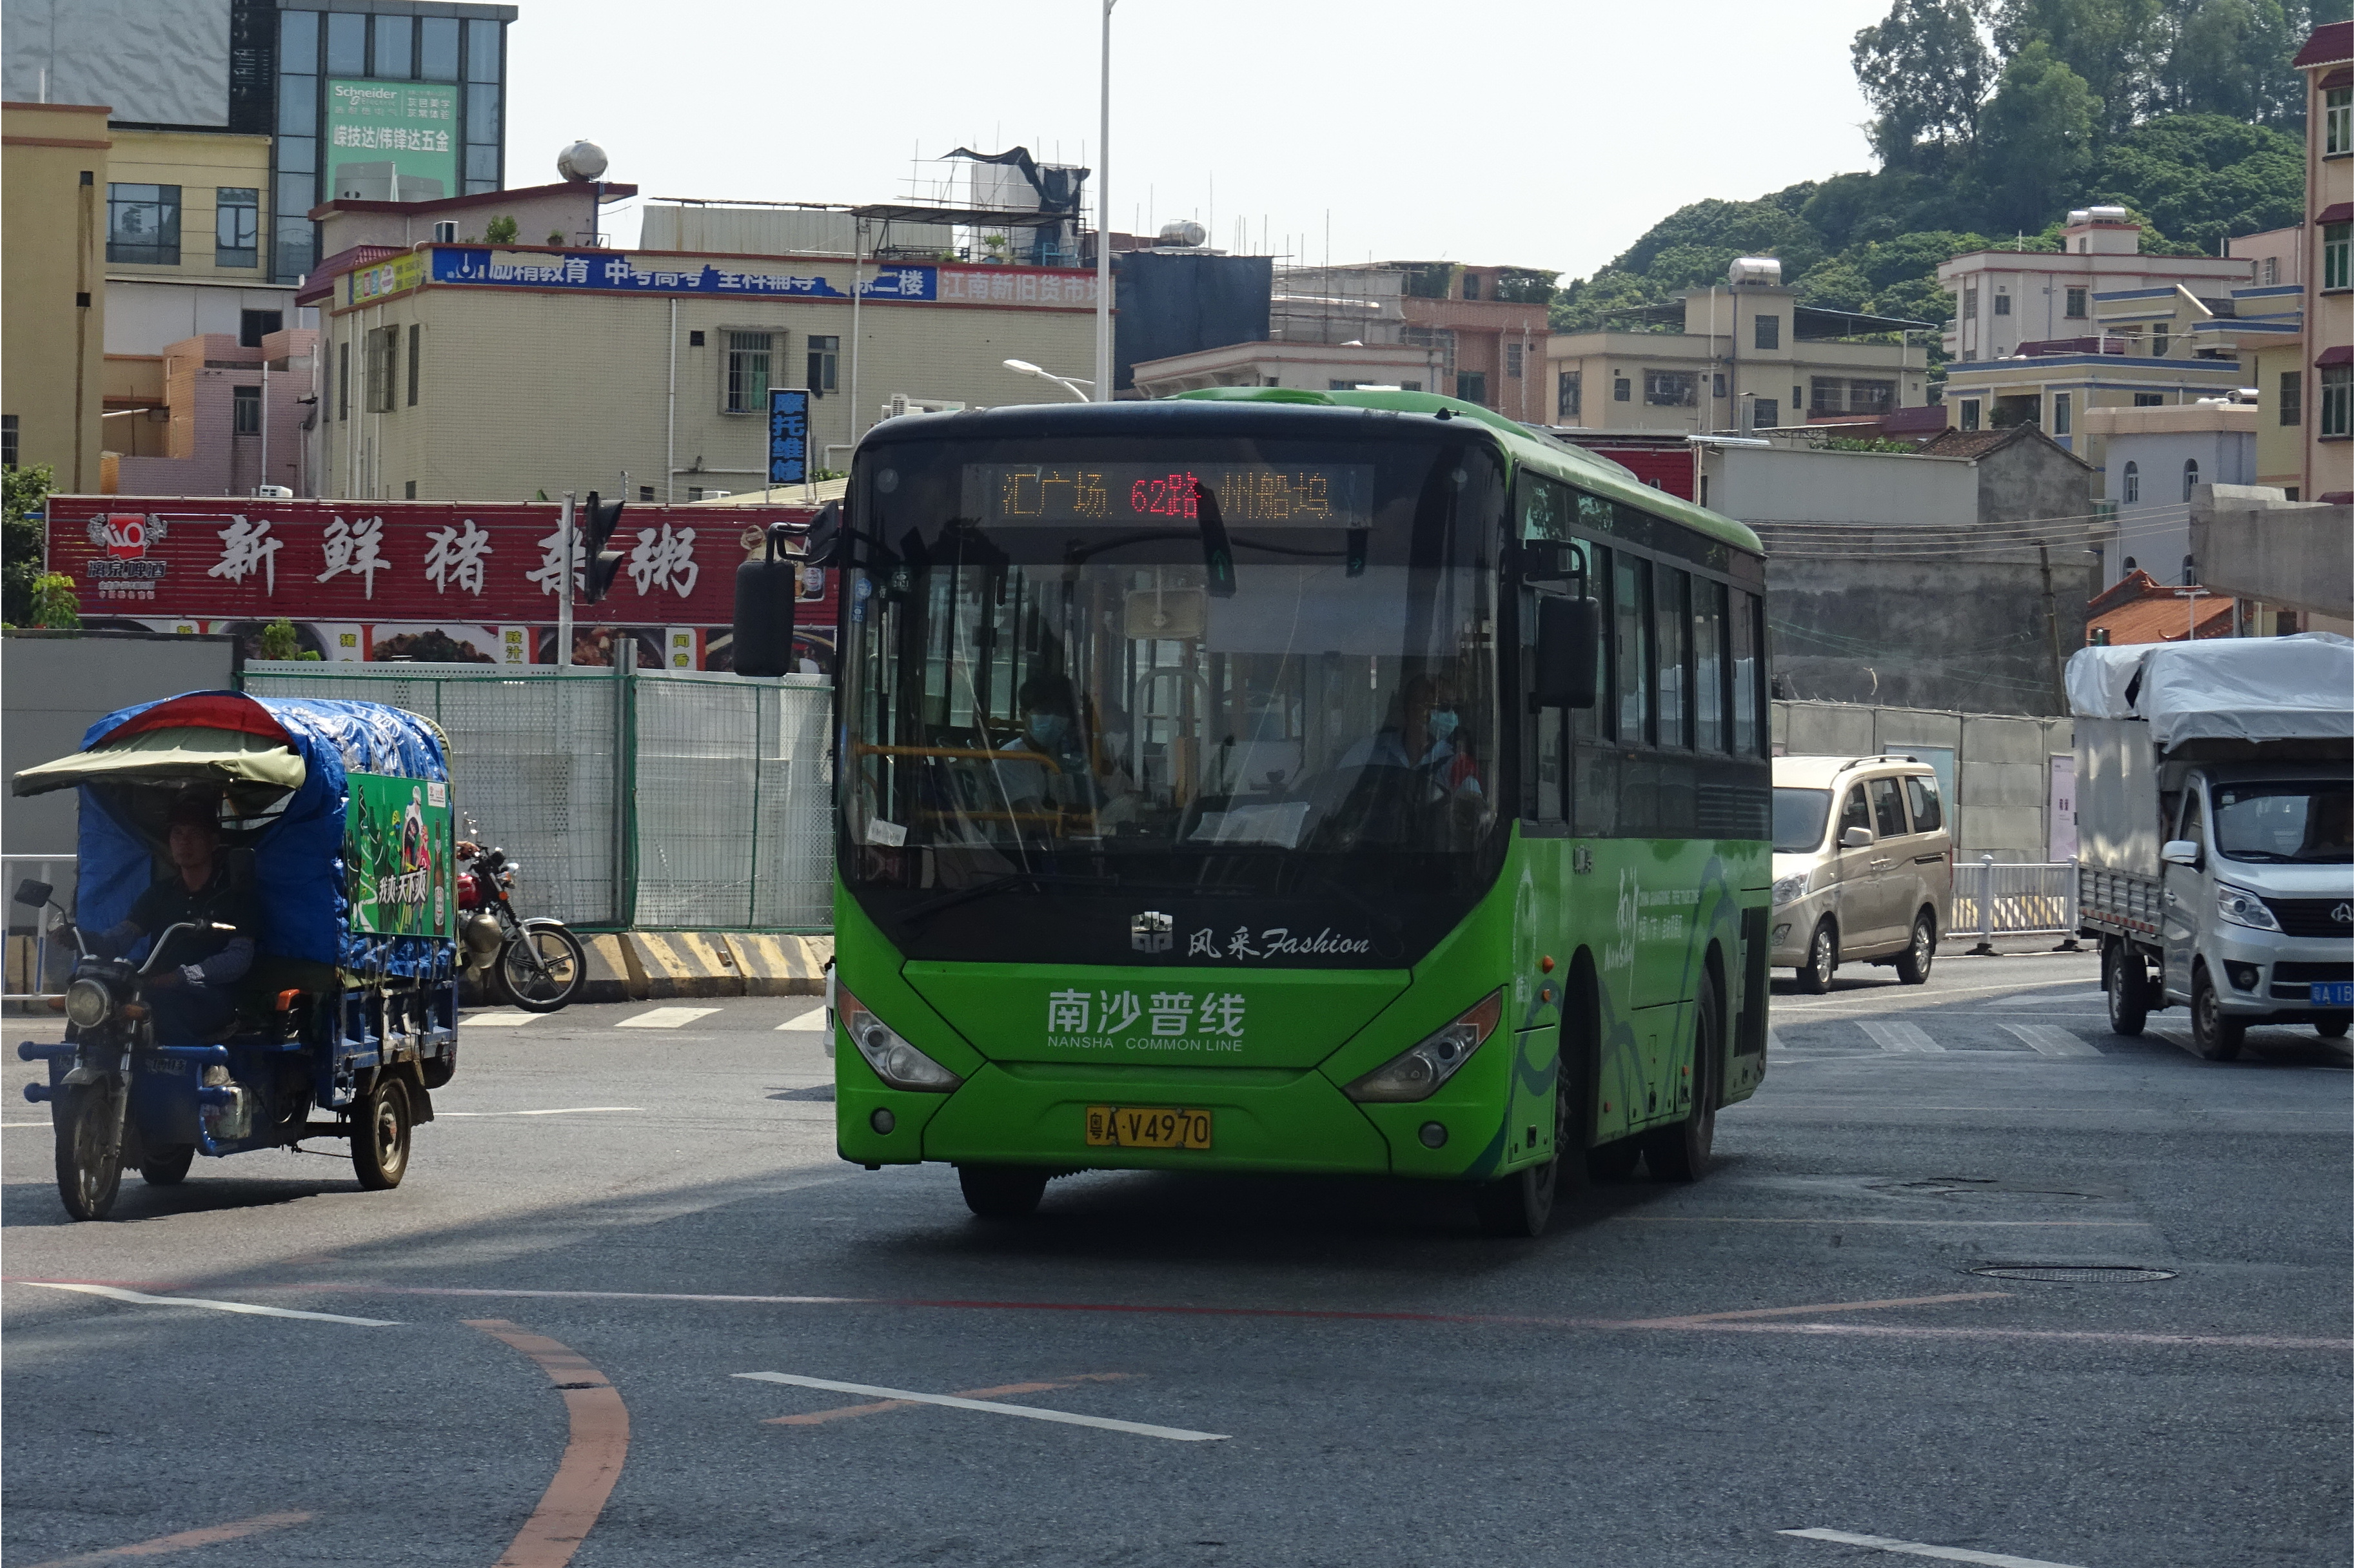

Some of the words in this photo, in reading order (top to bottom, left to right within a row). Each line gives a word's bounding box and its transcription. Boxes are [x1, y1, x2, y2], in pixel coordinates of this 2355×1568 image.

[335, 85, 397, 99] Schneider
[772, 393, 805, 482] 摩托维修
[1003, 471, 1112, 518] 汇广场
[1130, 471, 1201, 518] 62路
[1221, 471, 1333, 519] 州船坞
[505, 631, 523, 664] 豉汁
[1188, 926, 1260, 960] 风采
[1261, 927, 1370, 959] Fashion
[1047, 988, 1245, 1037] 南沙普线
[1048, 1035, 1114, 1049] NANSHA
[1126, 1037, 1200, 1051] COMMON
[1206, 1039, 1243, 1052] LINE
